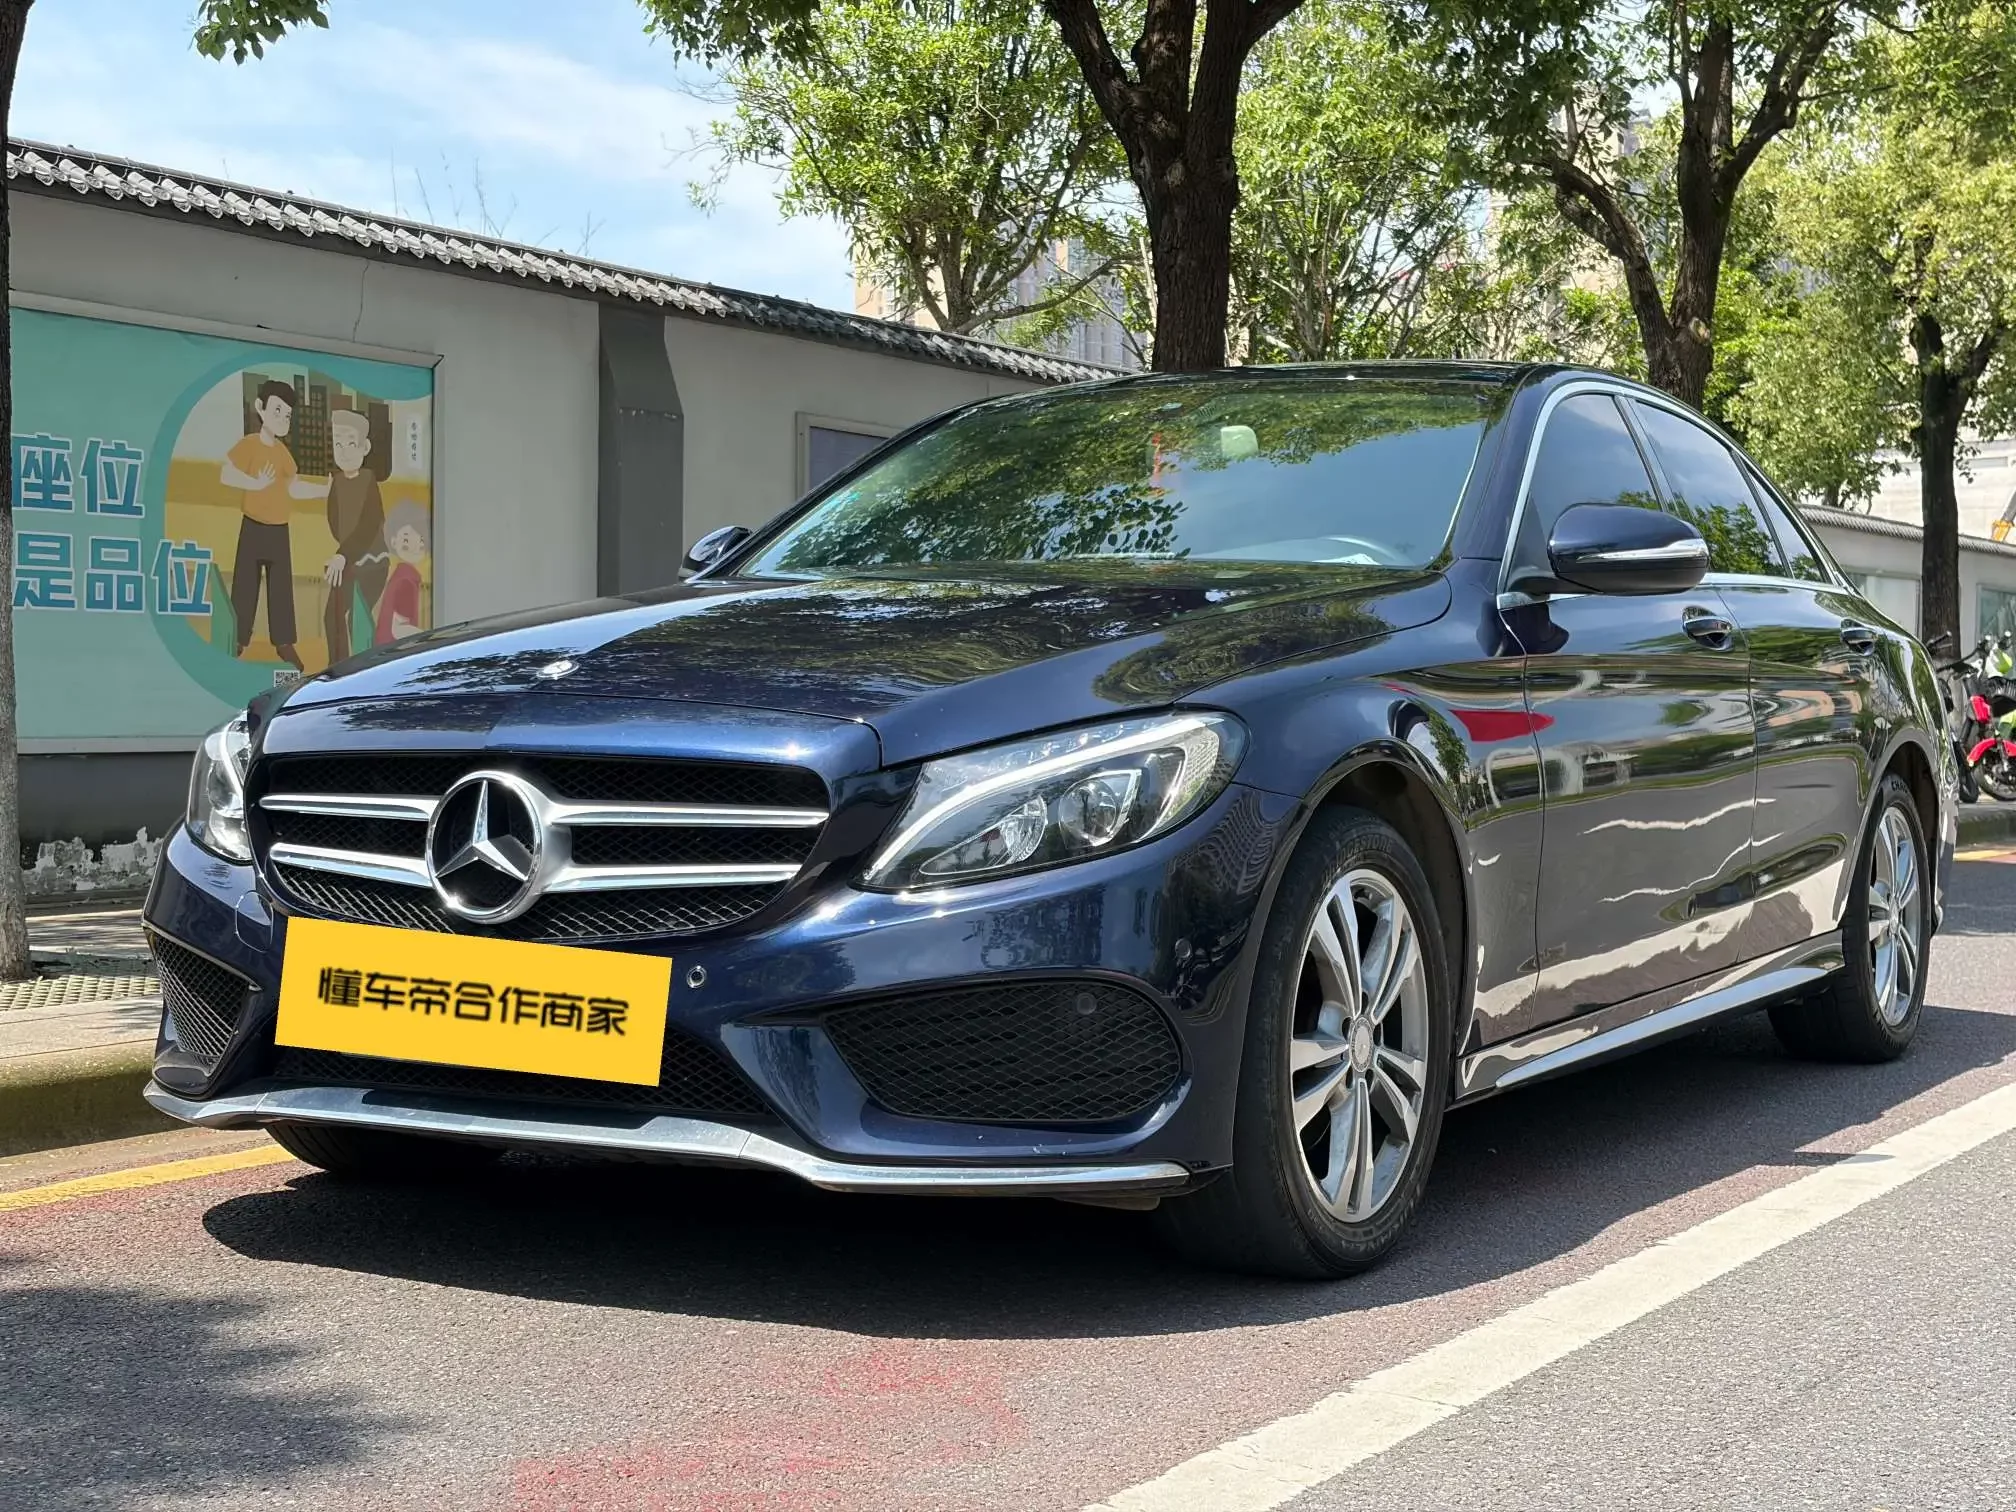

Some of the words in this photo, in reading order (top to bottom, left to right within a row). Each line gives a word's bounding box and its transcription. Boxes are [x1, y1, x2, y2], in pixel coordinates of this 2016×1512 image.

[11, 432, 144, 517] 座位
[12, 531, 213, 615] 是品位
